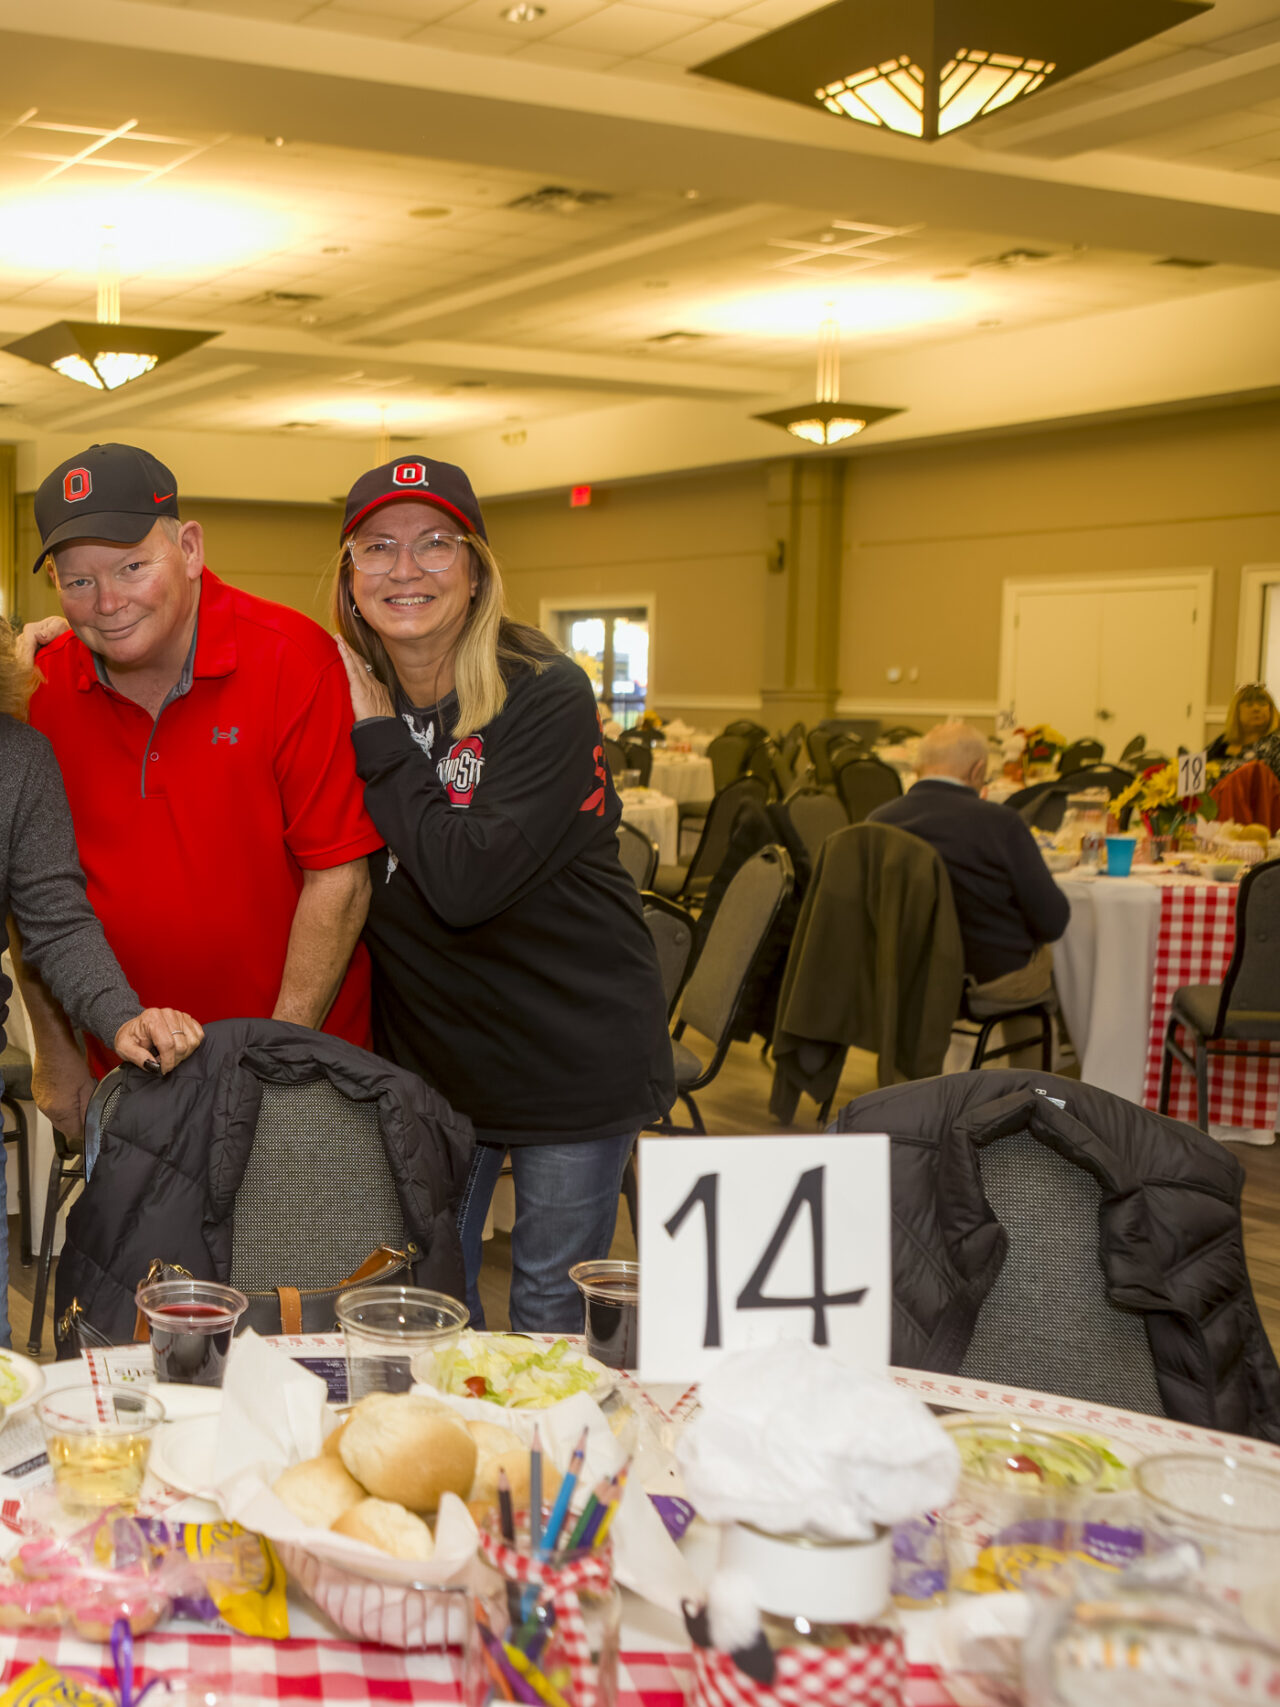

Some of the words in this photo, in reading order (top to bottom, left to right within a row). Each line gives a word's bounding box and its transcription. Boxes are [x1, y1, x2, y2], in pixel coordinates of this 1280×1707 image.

[63, 467, 92, 503] O
[393, 462, 426, 487] O
[1181, 756, 1202, 792] 18
[664, 1164, 869, 1349] 14
